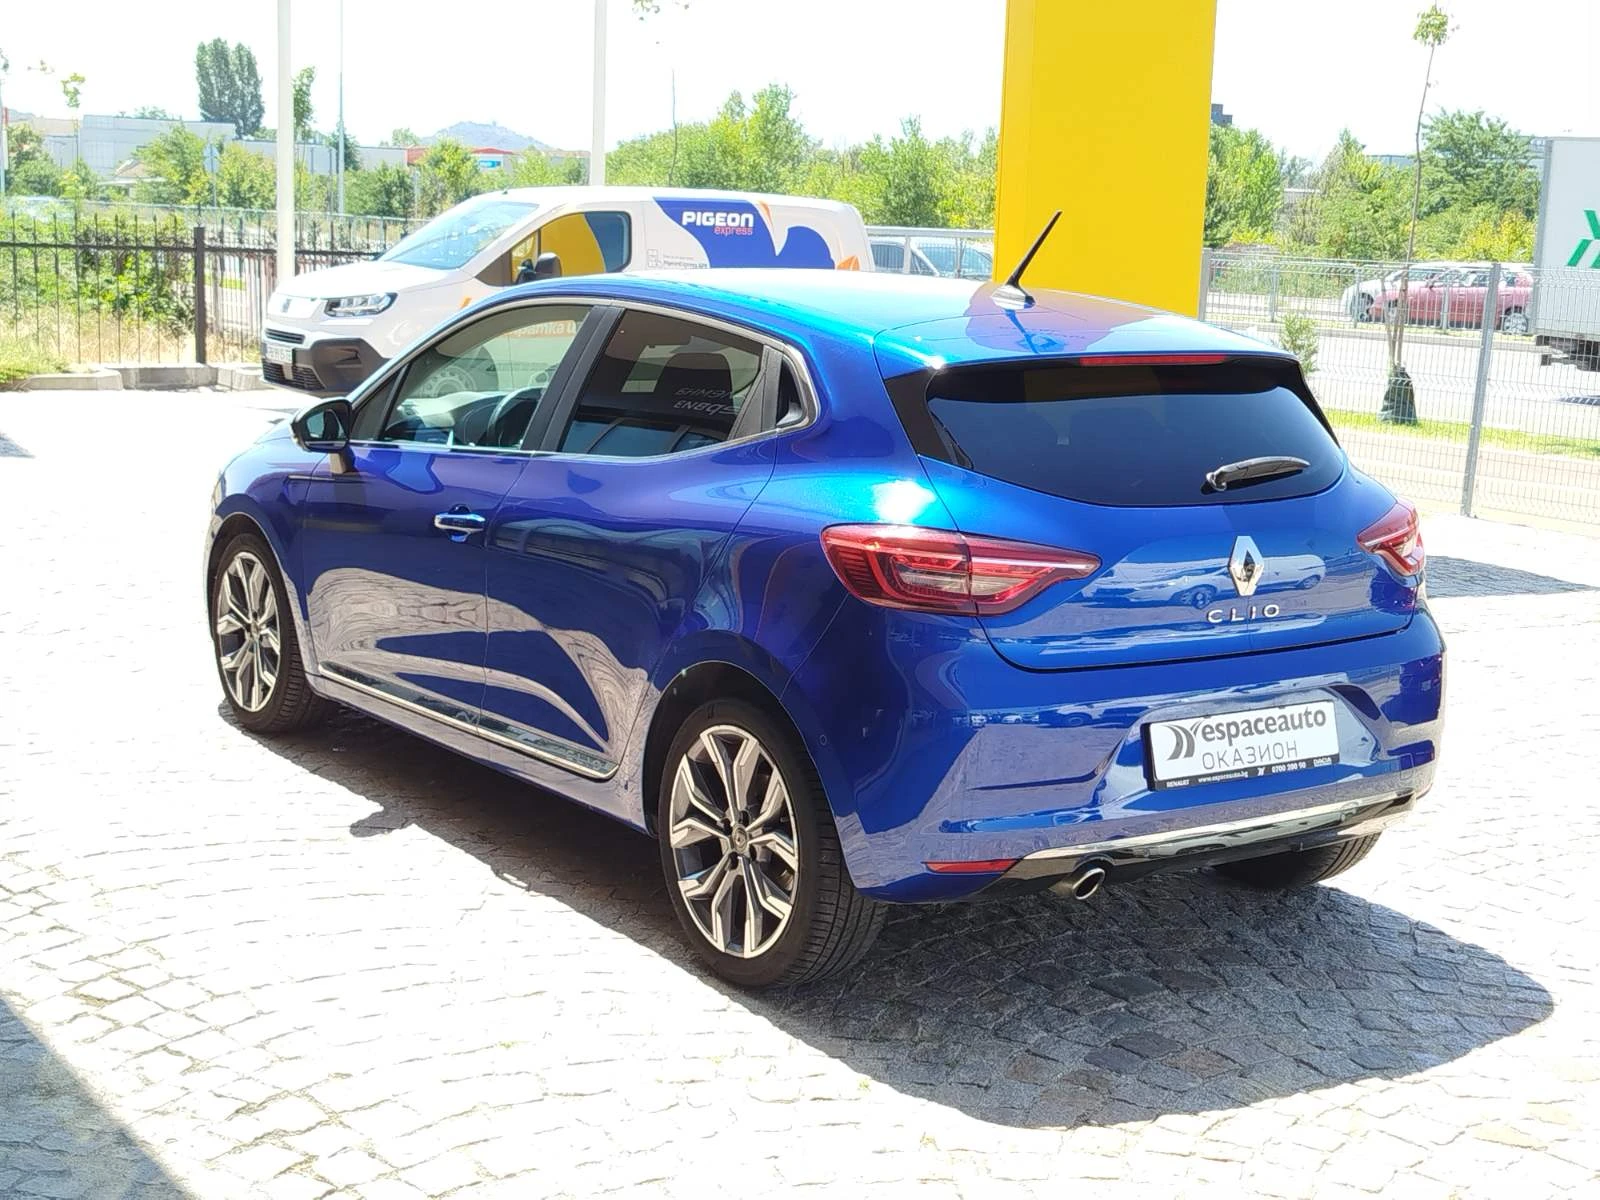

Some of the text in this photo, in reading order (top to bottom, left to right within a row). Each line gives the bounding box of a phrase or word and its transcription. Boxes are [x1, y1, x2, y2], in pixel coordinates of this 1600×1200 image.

[682, 211, 754, 227] PIGEON
[714, 226, 753, 236] express
[1207, 604, 1280, 623] CLIO
[1201, 706, 1327, 747] espaceauto
[1202, 740, 1298, 770] ОКАЗИОН
